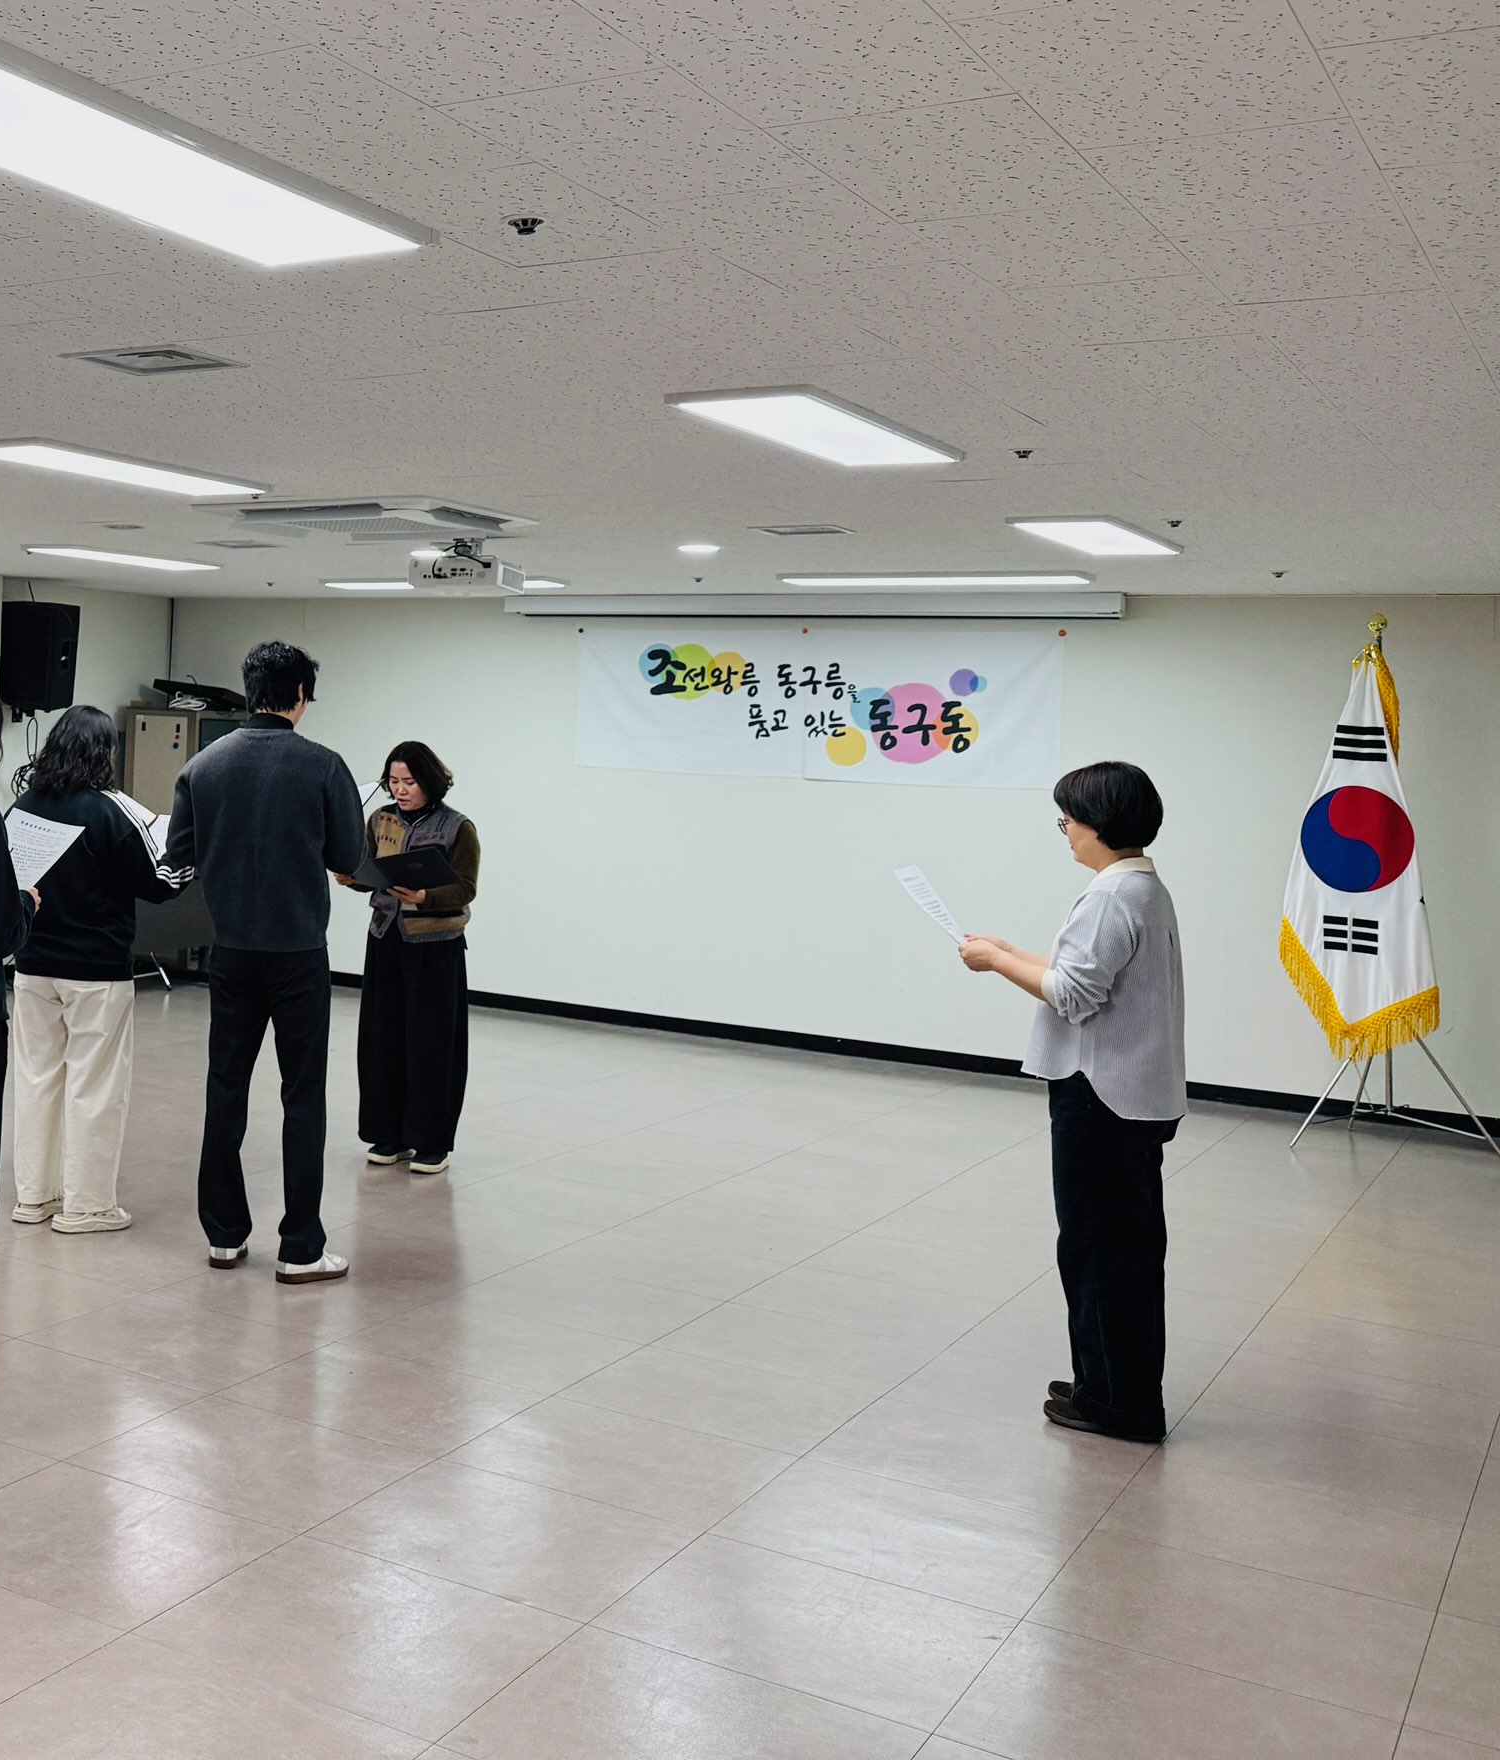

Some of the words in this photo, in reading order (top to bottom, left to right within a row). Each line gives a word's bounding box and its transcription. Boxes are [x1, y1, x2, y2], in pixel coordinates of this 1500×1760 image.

[647, 648, 761, 698] 조선왕릉
[747, 703, 789, 740] 품고
[803, 709, 848, 739] 있는
[868, 698, 973, 754] 동구동
